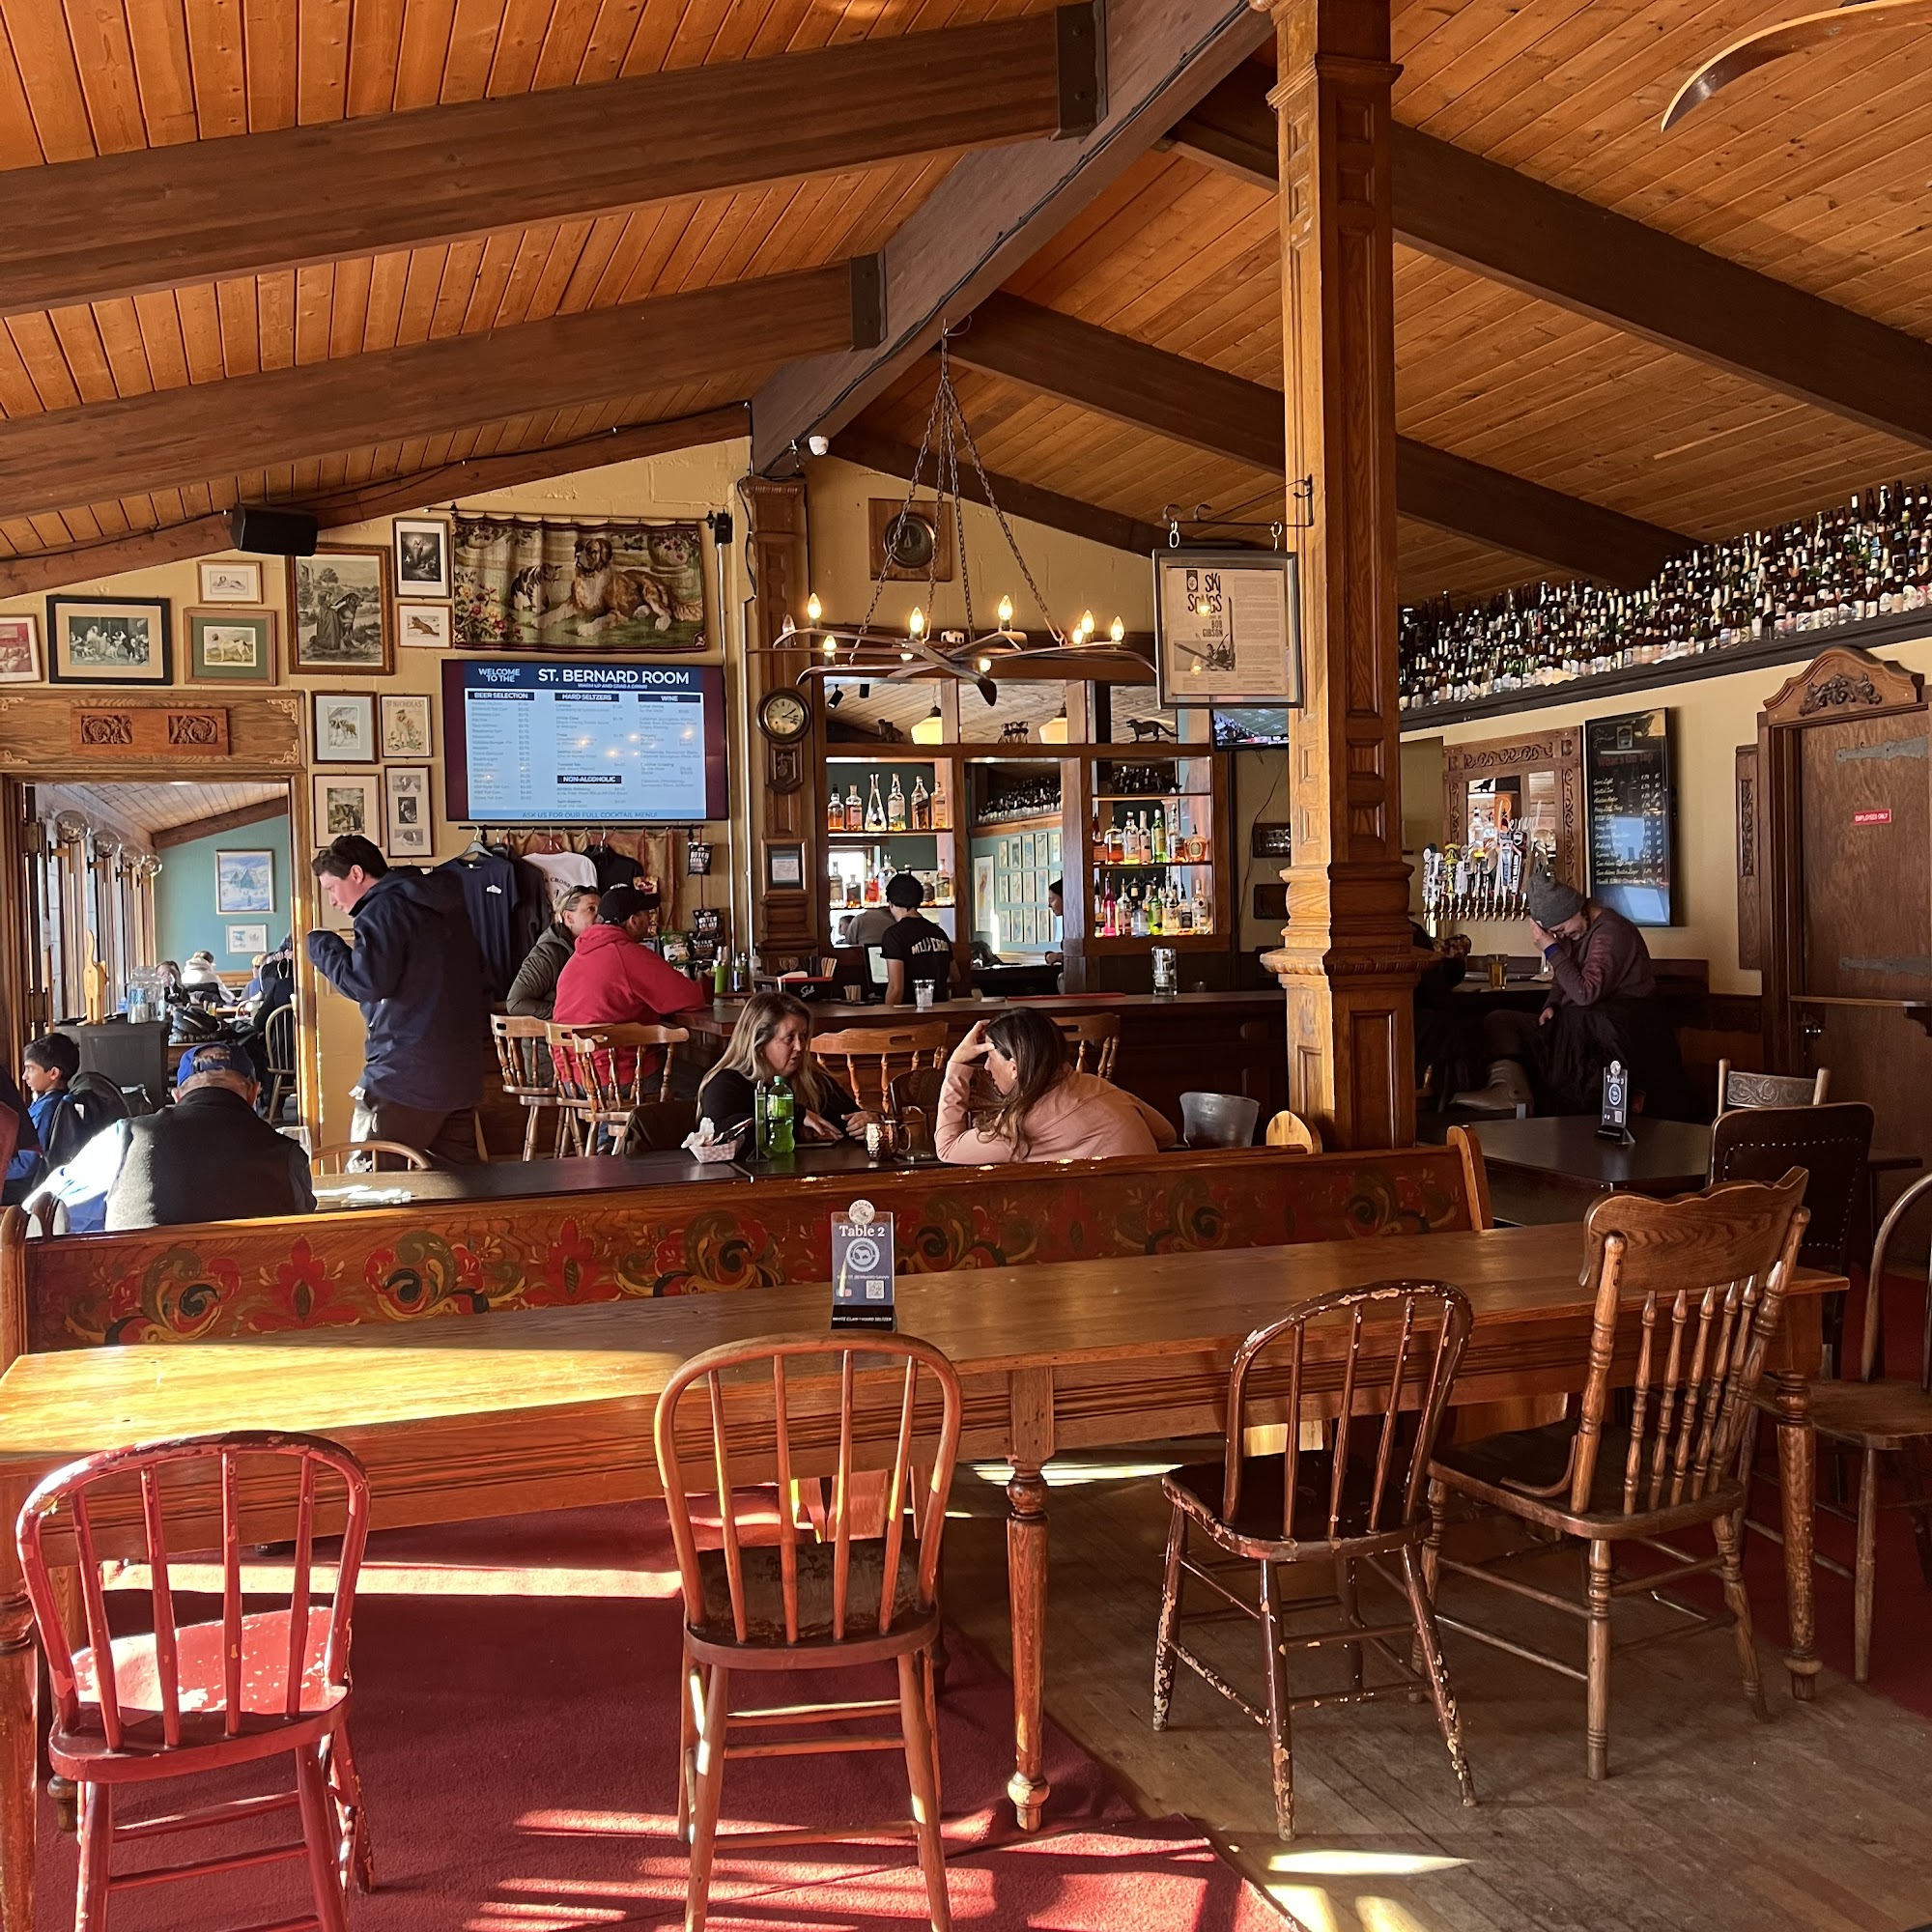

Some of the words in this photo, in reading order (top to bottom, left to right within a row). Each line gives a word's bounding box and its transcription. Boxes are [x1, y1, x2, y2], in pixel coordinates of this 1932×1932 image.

[1205, 573, 1221, 593] SKI
[1211, 620, 1222, 628] BOB
[1202, 628, 1223, 637] GIBSON
[538, 668, 559, 682] ST.
[563, 669, 639, 683] BERNARD
[642, 670, 689, 684] ROOM
[1606, 1075, 1620, 1083] Table
[838, 1224, 875, 1237] Table
[878, 1227, 885, 1237] 2
